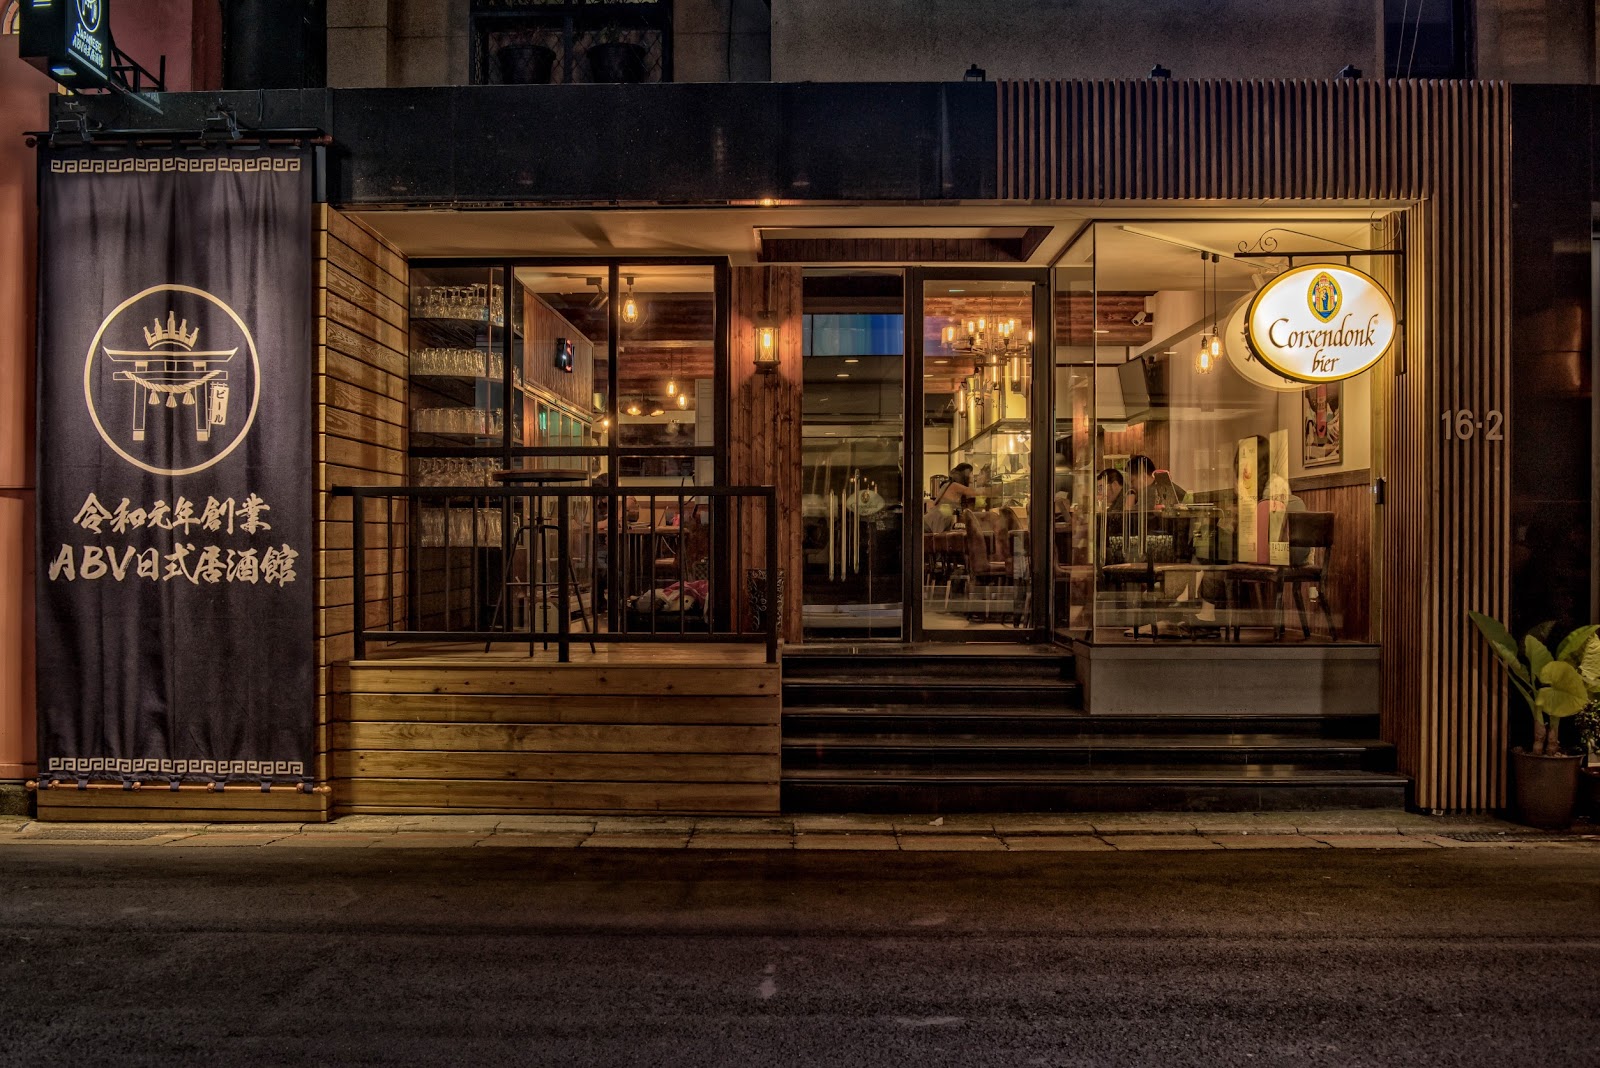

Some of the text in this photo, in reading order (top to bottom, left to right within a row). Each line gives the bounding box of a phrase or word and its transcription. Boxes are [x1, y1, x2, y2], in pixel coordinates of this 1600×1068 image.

[1268, 313, 1379, 349] Corsendonk
[1311, 349, 1340, 373] bier
[214, 389, 227, 424] ビール
[1441, 409, 1504, 440] 16-2
[72, 493, 272, 535] 令和元年創業
[48, 542, 299, 587] ABV日式居酒館
